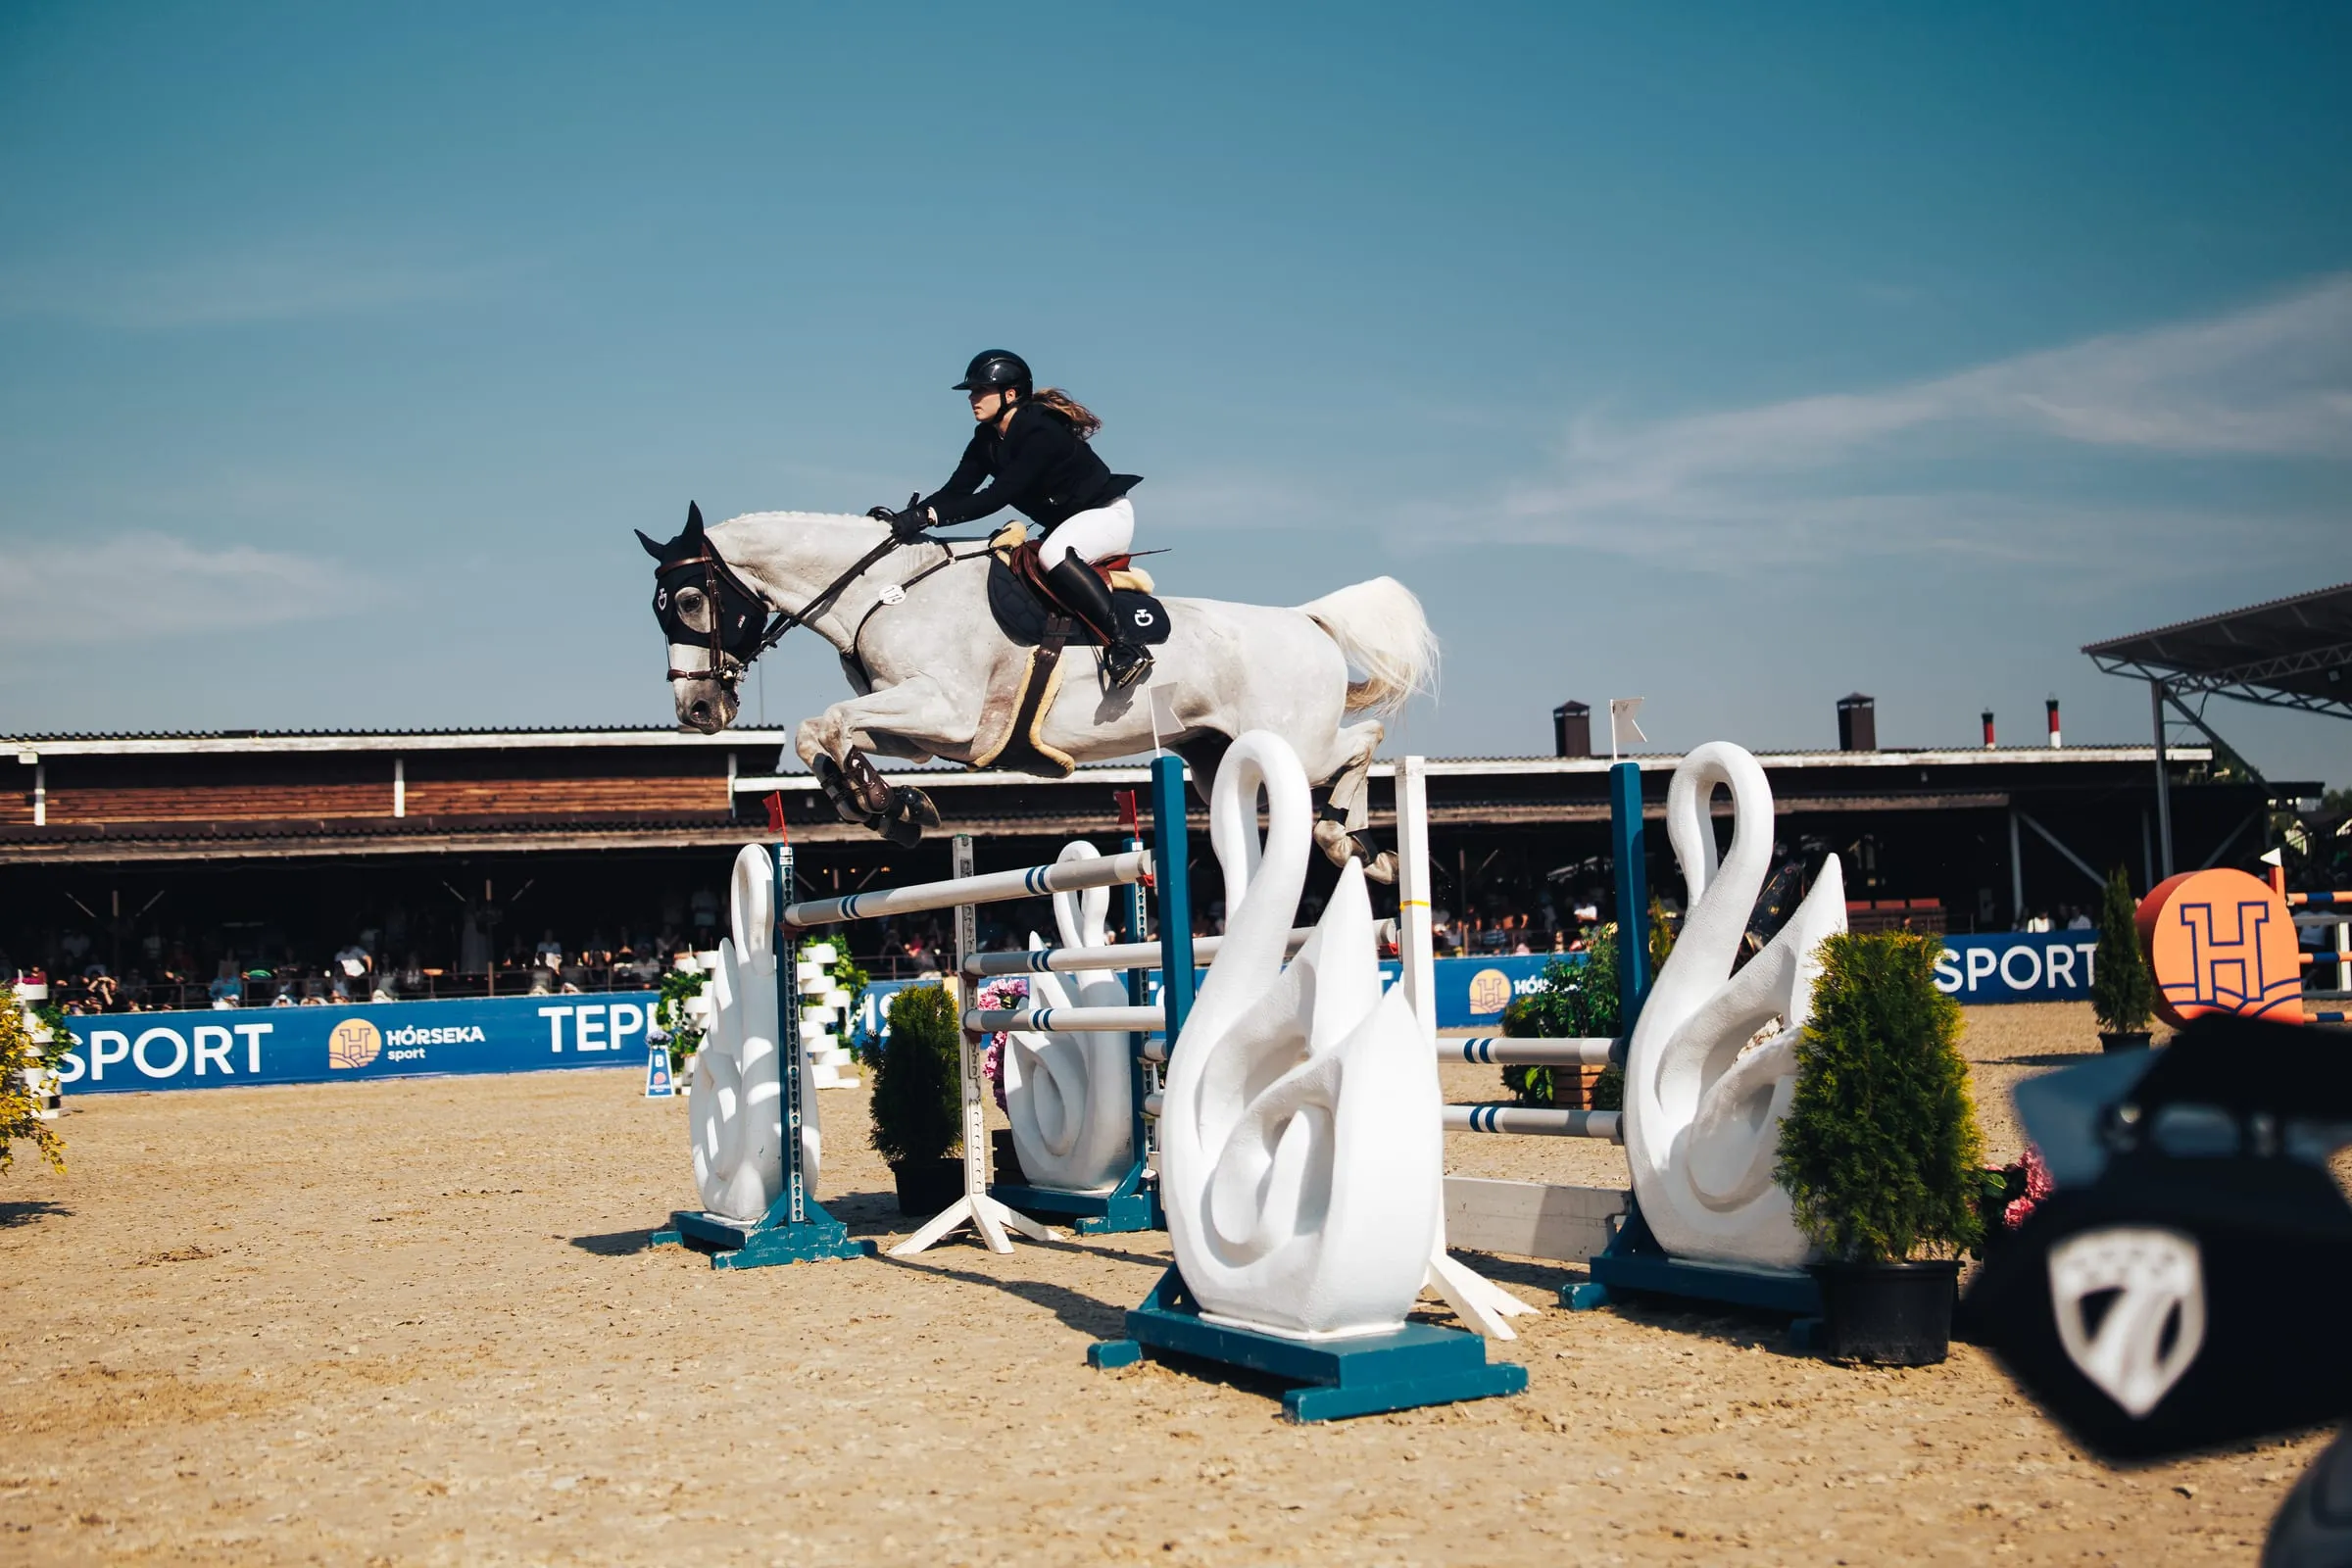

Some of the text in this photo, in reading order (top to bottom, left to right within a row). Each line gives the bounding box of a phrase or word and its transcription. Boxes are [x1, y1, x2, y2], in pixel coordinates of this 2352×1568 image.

[385, 1024, 486, 1047] HÓRSEKA
[387, 1047, 426, 1062] sport
[655, 1054, 664, 1067] B
